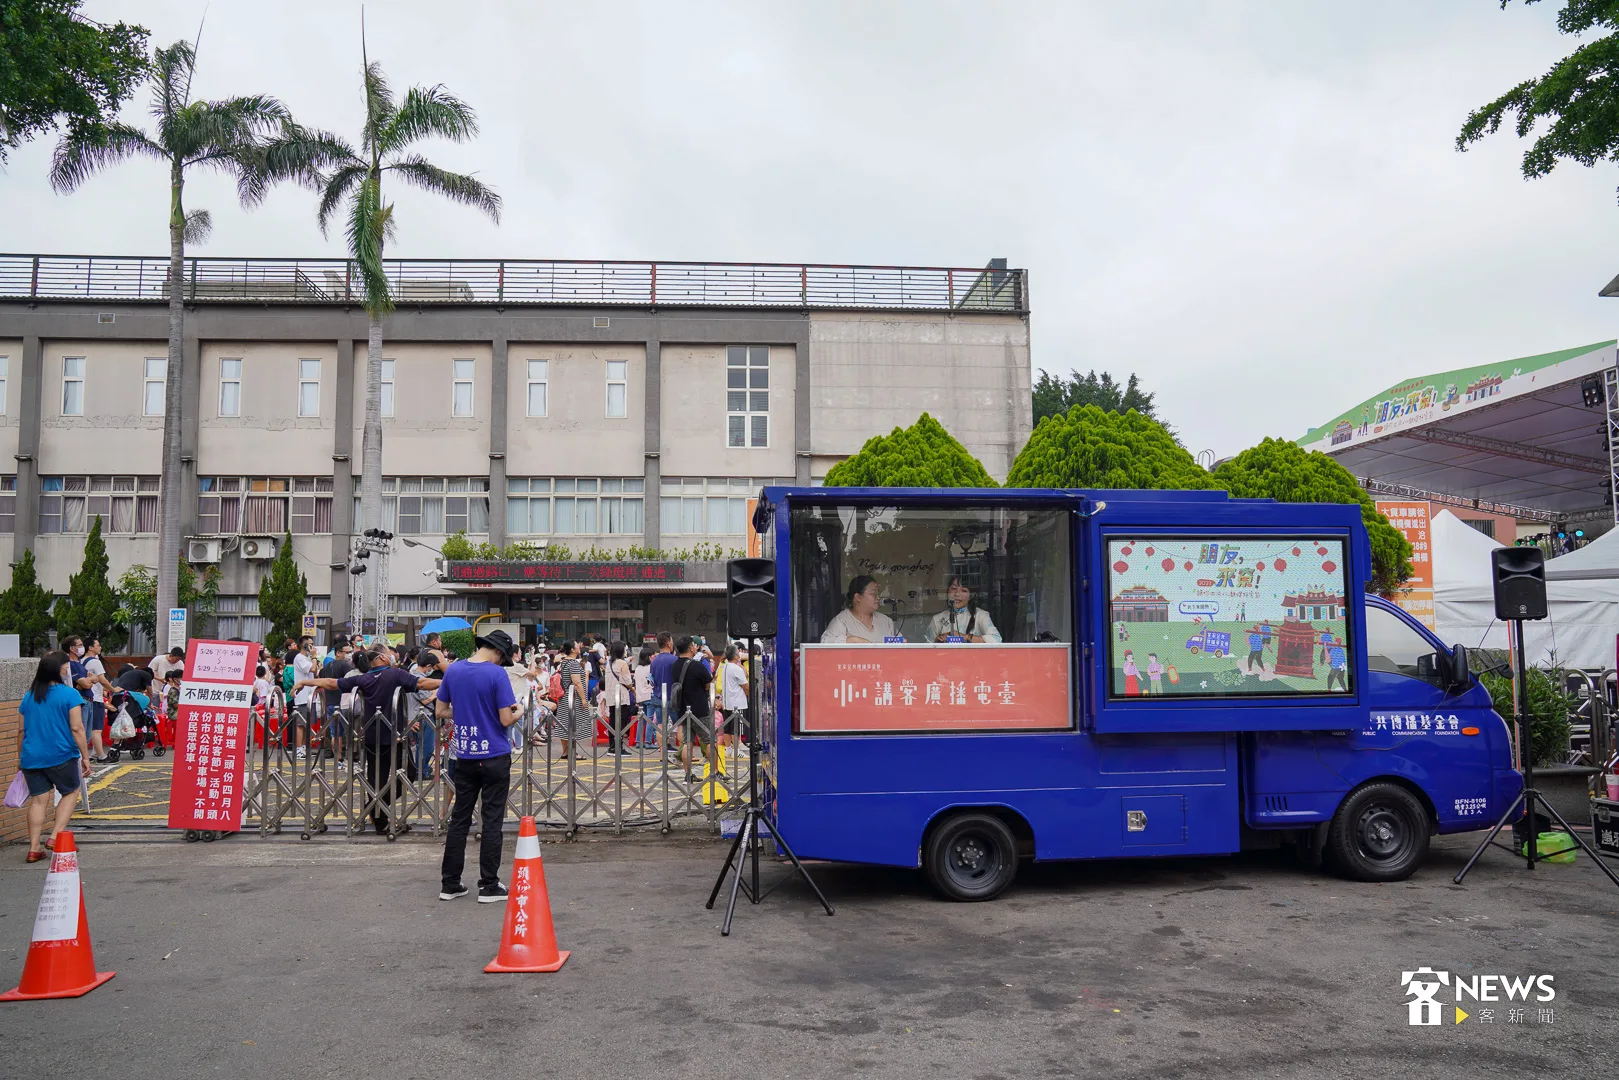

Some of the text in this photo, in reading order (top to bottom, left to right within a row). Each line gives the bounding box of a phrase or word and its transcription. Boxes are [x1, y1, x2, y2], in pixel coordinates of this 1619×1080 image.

[185, 688, 248, 702] 不開放停車
[874, 680, 1016, 706] 講客廣播電臺
[1370, 714, 1459, 730] 共傳播基金會
